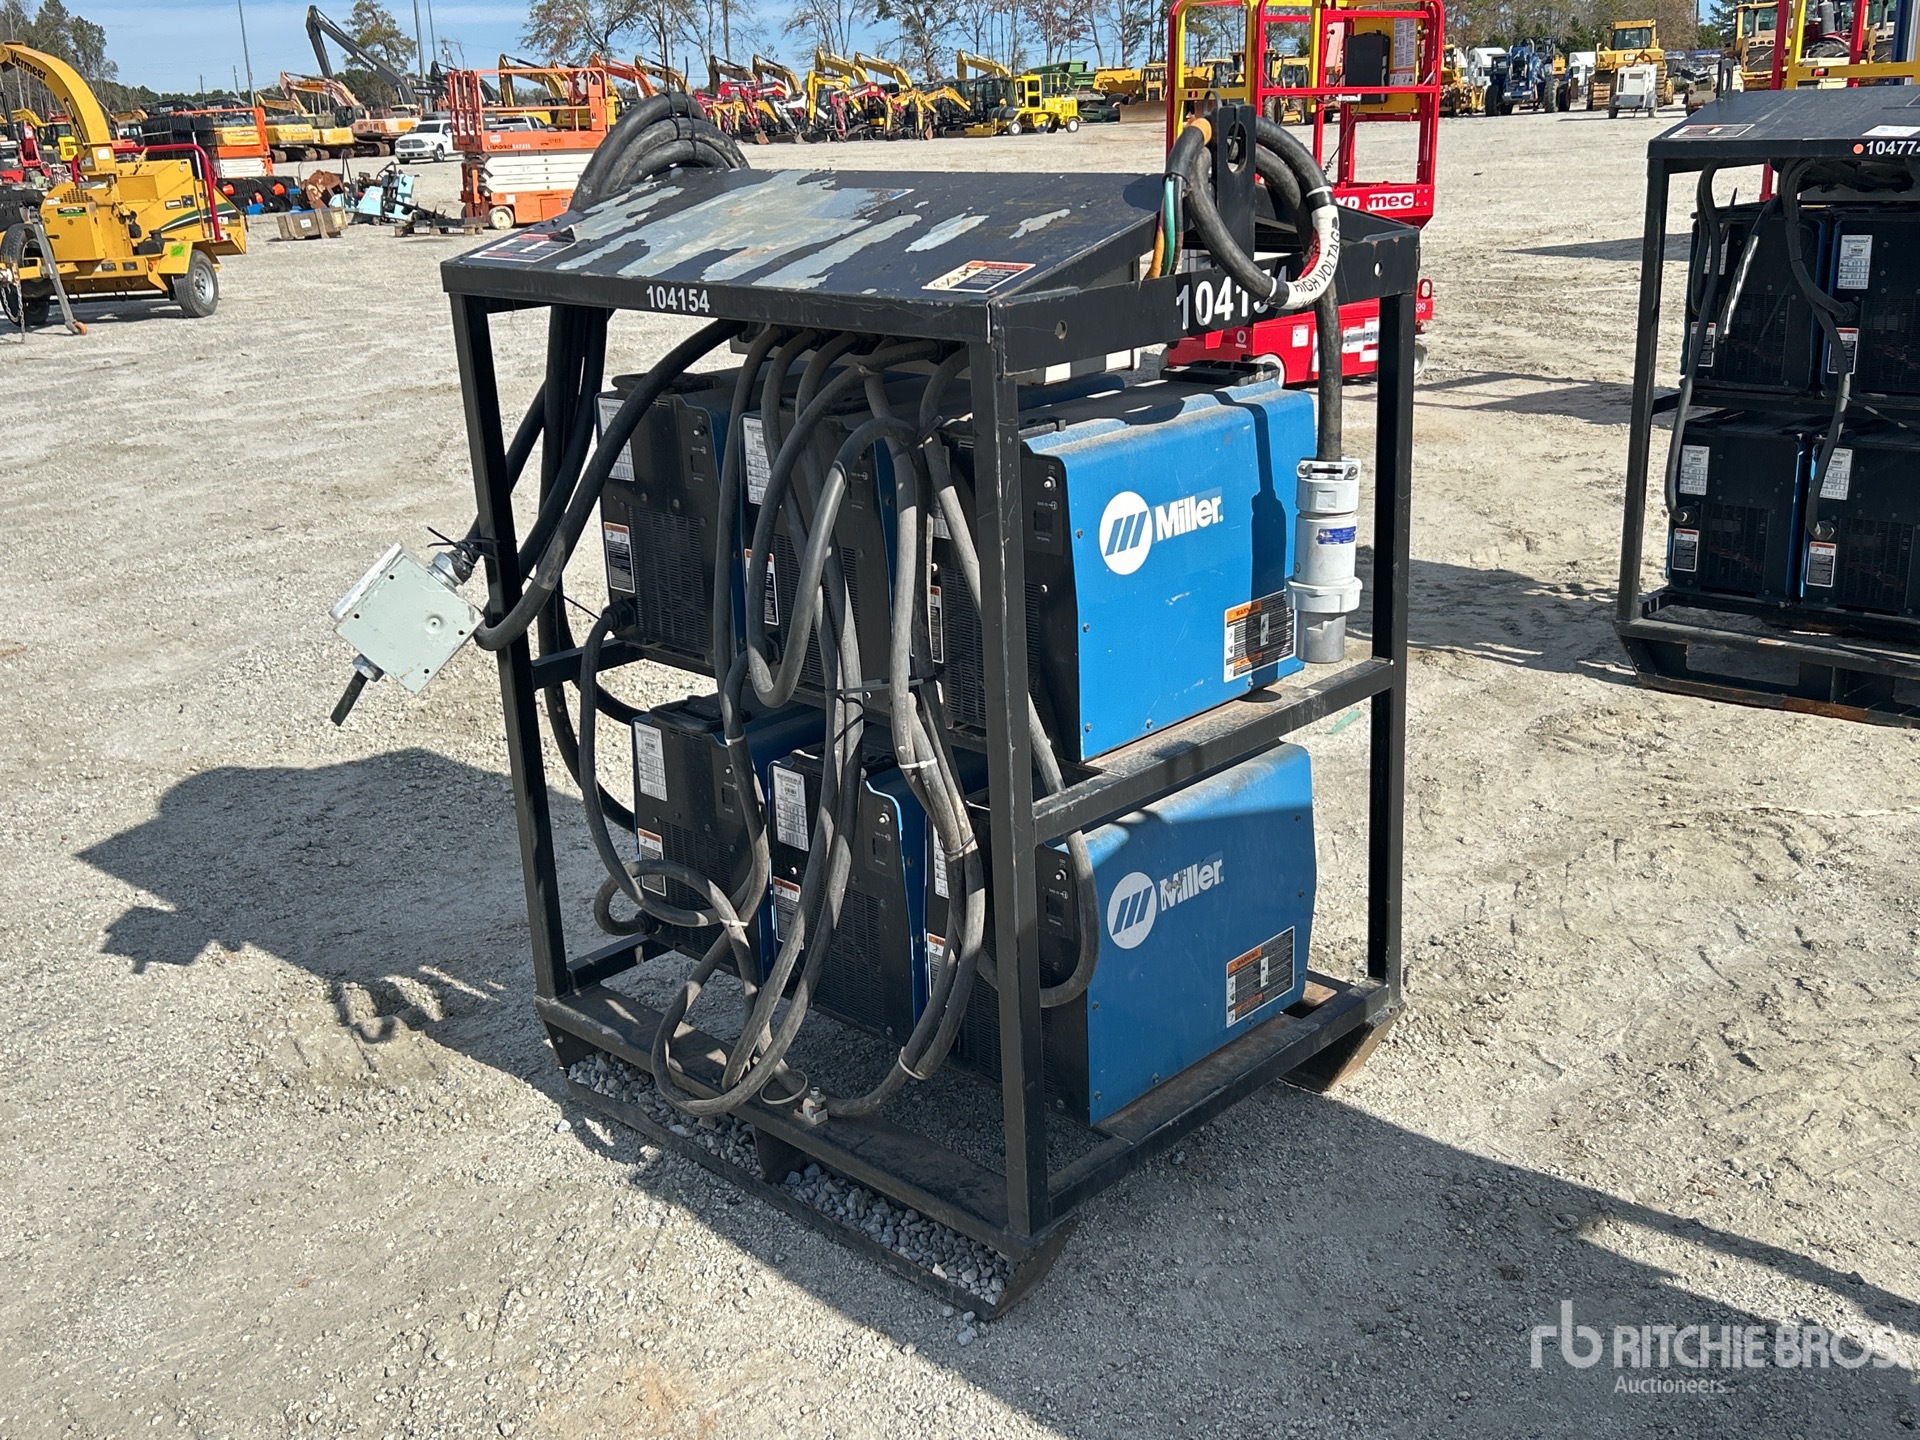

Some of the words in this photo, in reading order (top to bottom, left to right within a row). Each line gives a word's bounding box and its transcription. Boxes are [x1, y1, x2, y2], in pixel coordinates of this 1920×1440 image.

[10, 49, 47, 81] Vermeer
[1369, 194, 1413, 209] mec
[1293, 277, 1321, 293] HIGH
[646, 284, 711, 314] 104154
